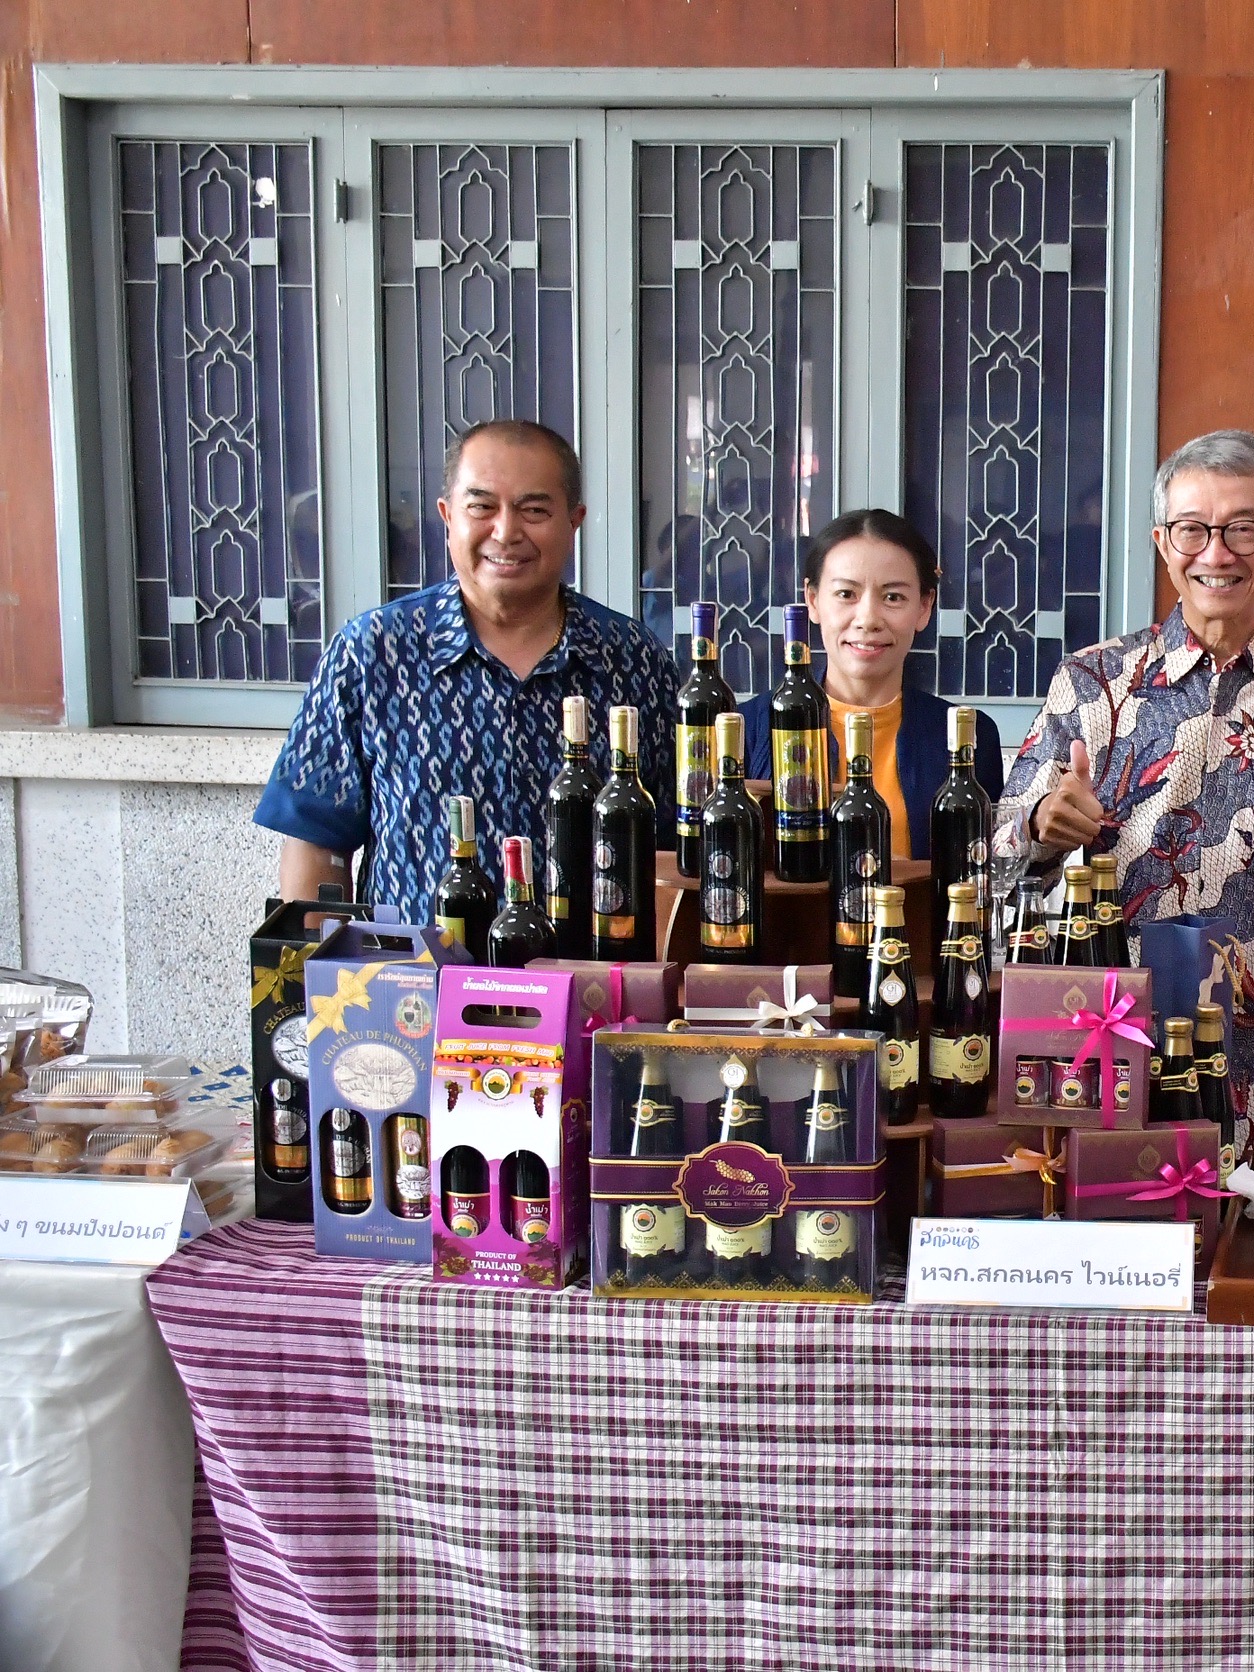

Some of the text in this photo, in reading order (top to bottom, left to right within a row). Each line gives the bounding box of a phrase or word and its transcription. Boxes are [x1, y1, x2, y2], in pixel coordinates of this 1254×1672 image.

[322, 1032, 363, 1066] CHATEAU
[366, 1030, 381, 1040] DE
[702, 1182, 770, 1196] Sakon Nakhon
[35, 1218, 173, 1240] ขนมปังปอนด์
[345, 1233, 416, 1246] PRODUCT OF THAILAND
[475, 1250, 507, 1259] PRODUCT
[471, 1259, 522, 1272] THAILAND
[920, 1259, 1182, 1287] หจก.สกลนคร ไวน์เนอรี่
